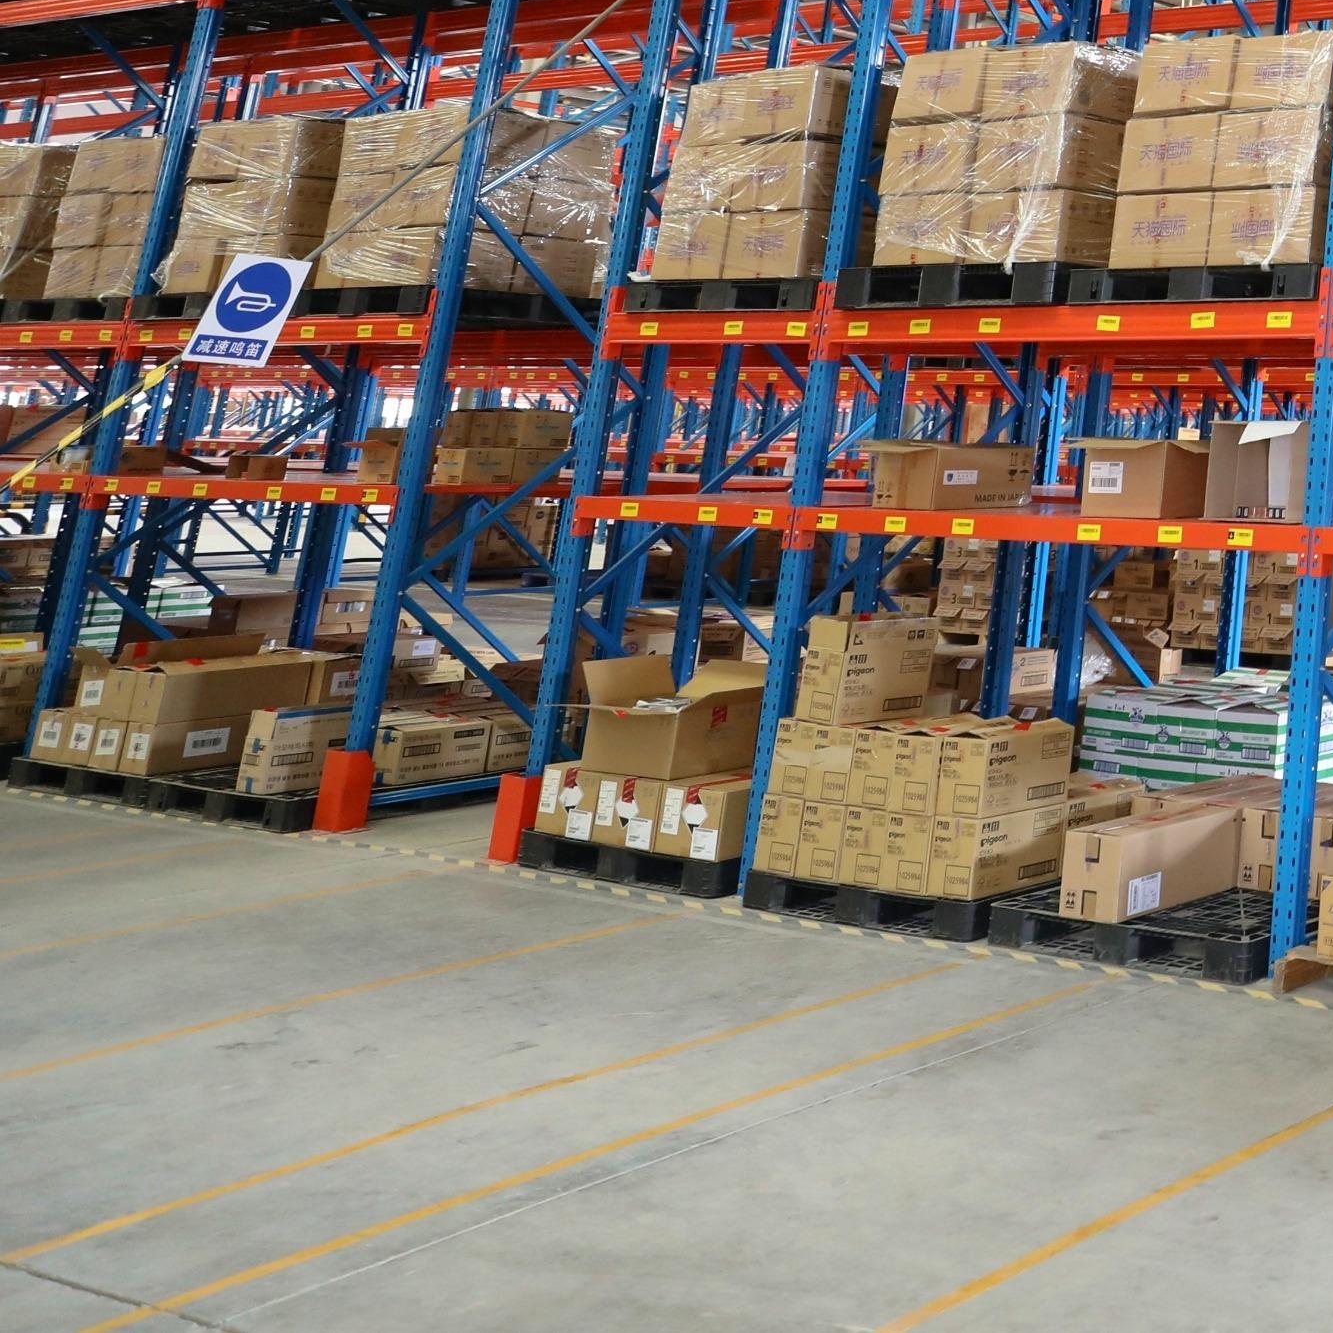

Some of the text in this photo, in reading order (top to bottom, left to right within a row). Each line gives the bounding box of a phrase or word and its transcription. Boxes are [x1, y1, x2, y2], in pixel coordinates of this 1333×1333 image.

[196, 339, 263, 357] 减速鸣笛
[975, 494, 996, 503] MADE
[847, 667, 875, 677] pigeon
[990, 754, 1017, 766] pigeon
[1068, 813, 1093, 827] pigeon
[981, 833, 1008, 847] pigeon
